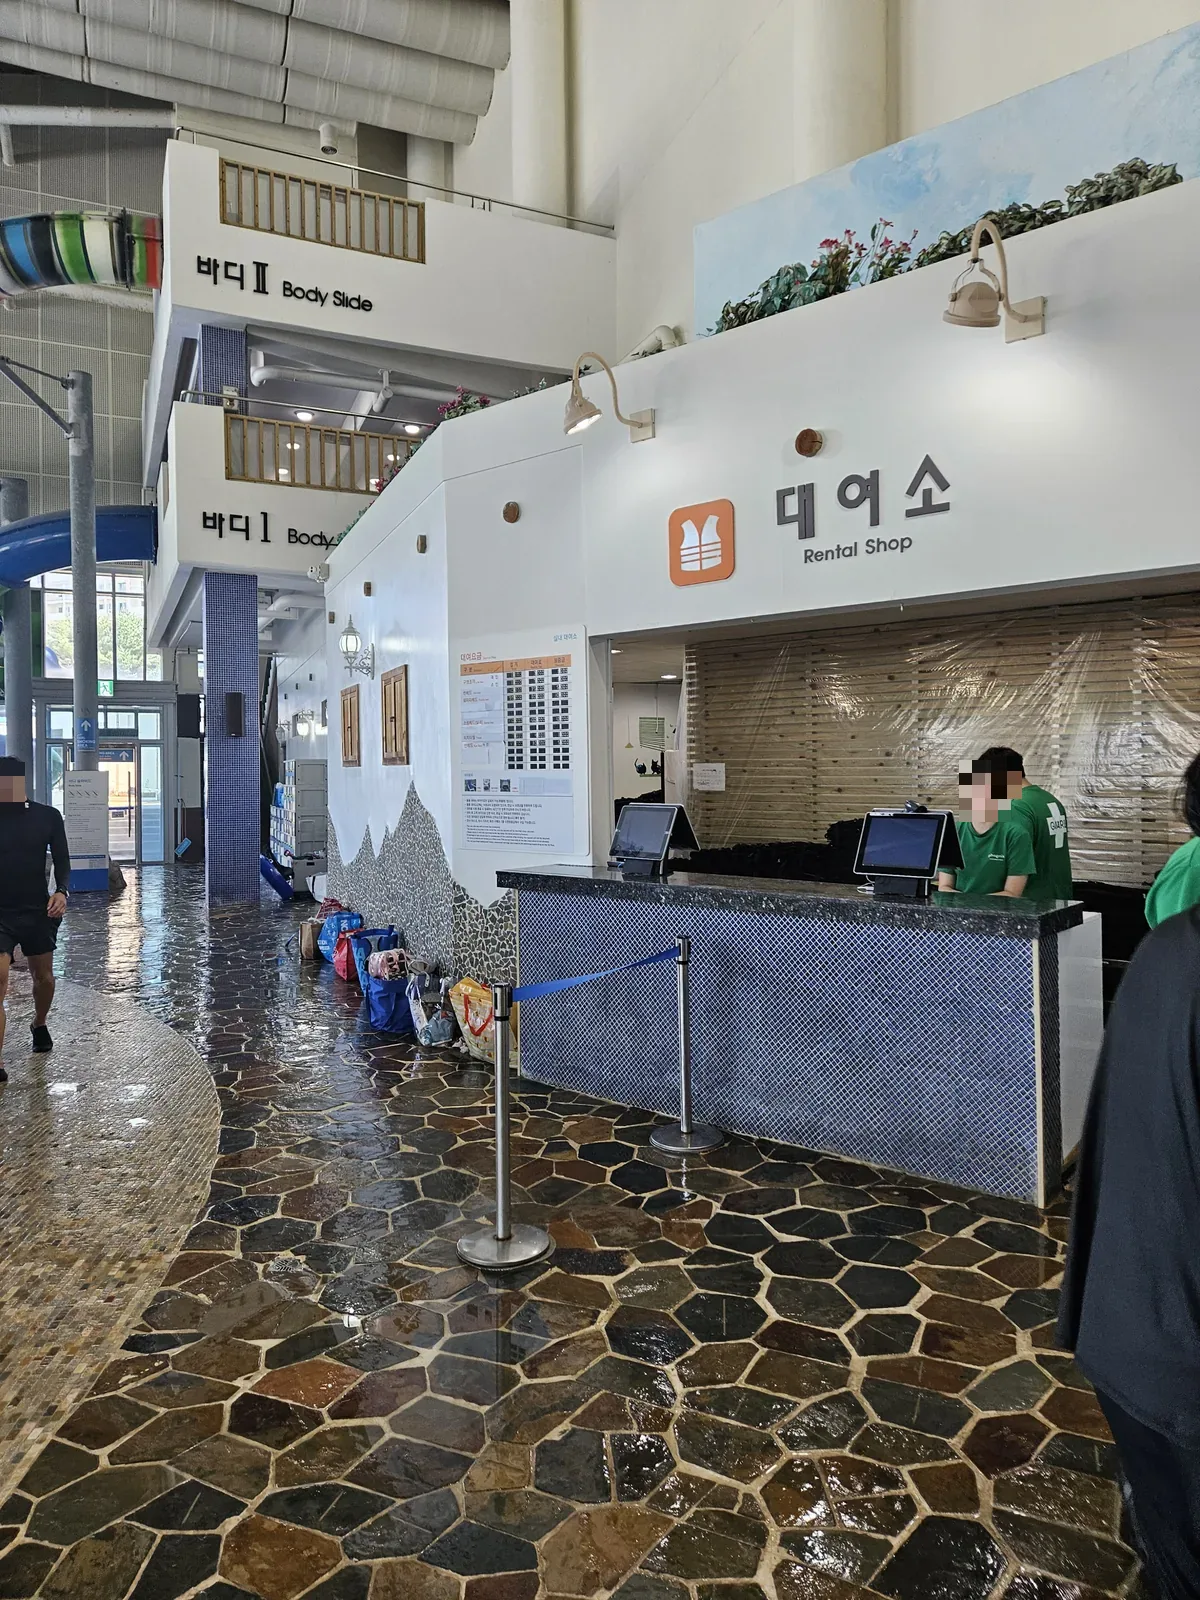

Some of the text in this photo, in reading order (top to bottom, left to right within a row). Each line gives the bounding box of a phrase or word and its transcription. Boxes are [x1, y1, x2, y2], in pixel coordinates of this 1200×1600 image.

[196, 255, 245, 291] 바디
[282, 280, 373, 312] Body Slide
[775, 453, 951, 540] 대여소
[202, 511, 250, 541] 바디
[287, 528, 334, 550] Body
[803, 535, 913, 564] Rental Shop
[460, 651, 482, 661] 대여요금
